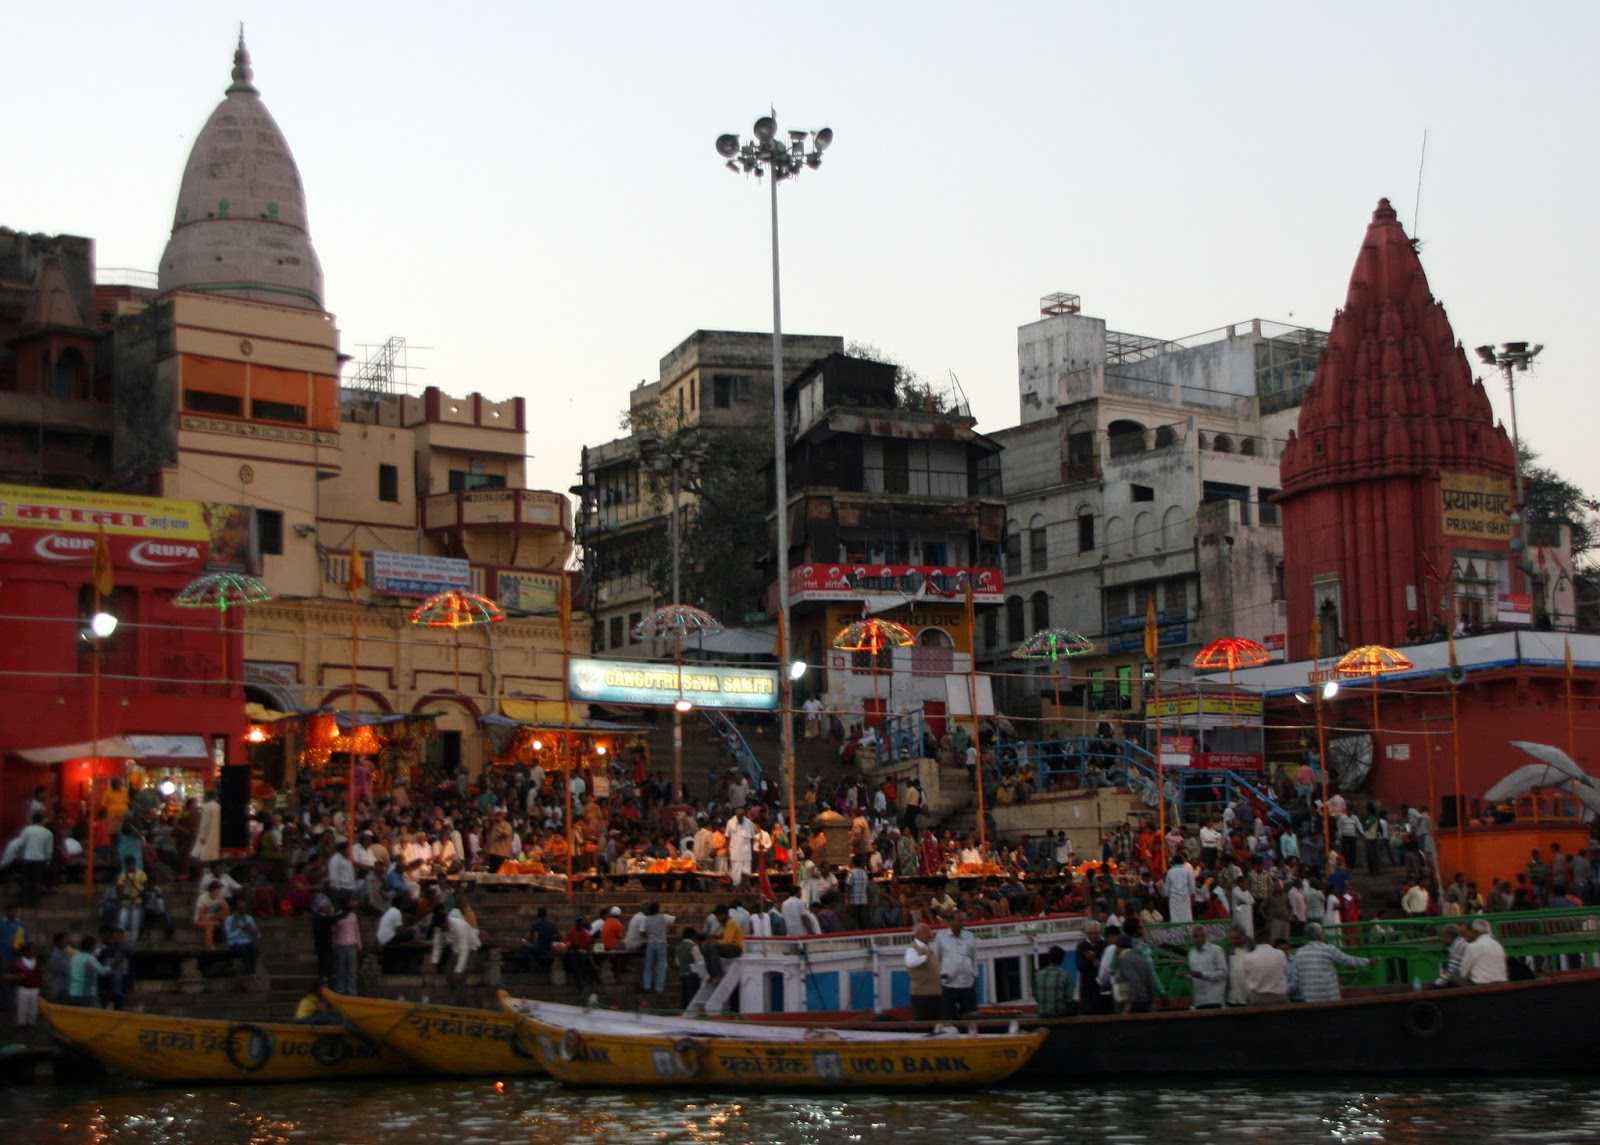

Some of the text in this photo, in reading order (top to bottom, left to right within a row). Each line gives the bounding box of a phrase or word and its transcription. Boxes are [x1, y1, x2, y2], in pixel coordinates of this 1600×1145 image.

[1447, 517, 1484, 533] PRAYAG
[54, 535, 96, 551] RUP
[147, 542, 200, 559] RUPA
[606, 669, 775, 696] GANGOTRI SEVA SAMITI
[851, 1055, 971, 1073] UCO BANK
